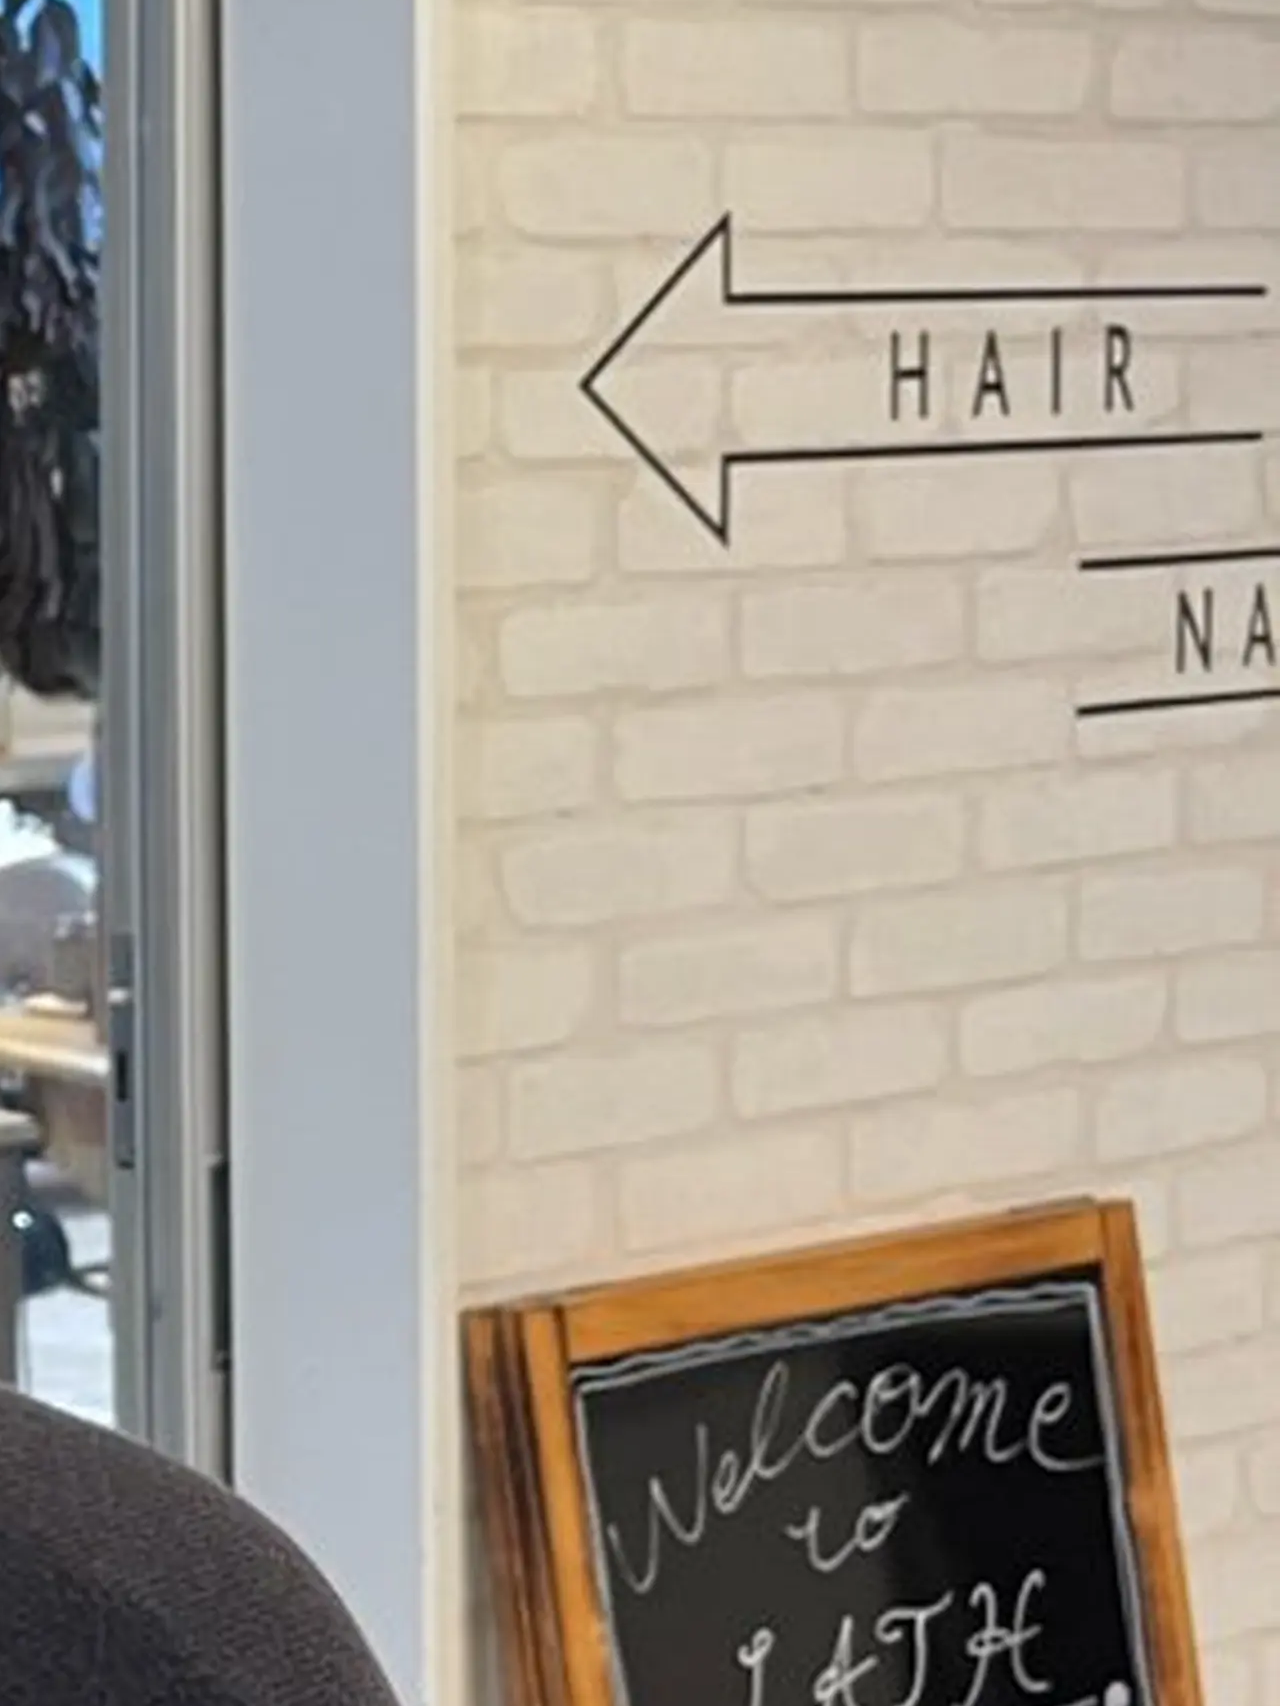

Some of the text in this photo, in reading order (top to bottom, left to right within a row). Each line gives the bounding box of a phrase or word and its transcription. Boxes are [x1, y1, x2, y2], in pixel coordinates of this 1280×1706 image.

[888, 325, 1135, 421] HAIR
[1176, 583, 1277, 674] NA
[607, 1360, 1104, 1593] Welcome
[786, 1493, 909, 1572] to
